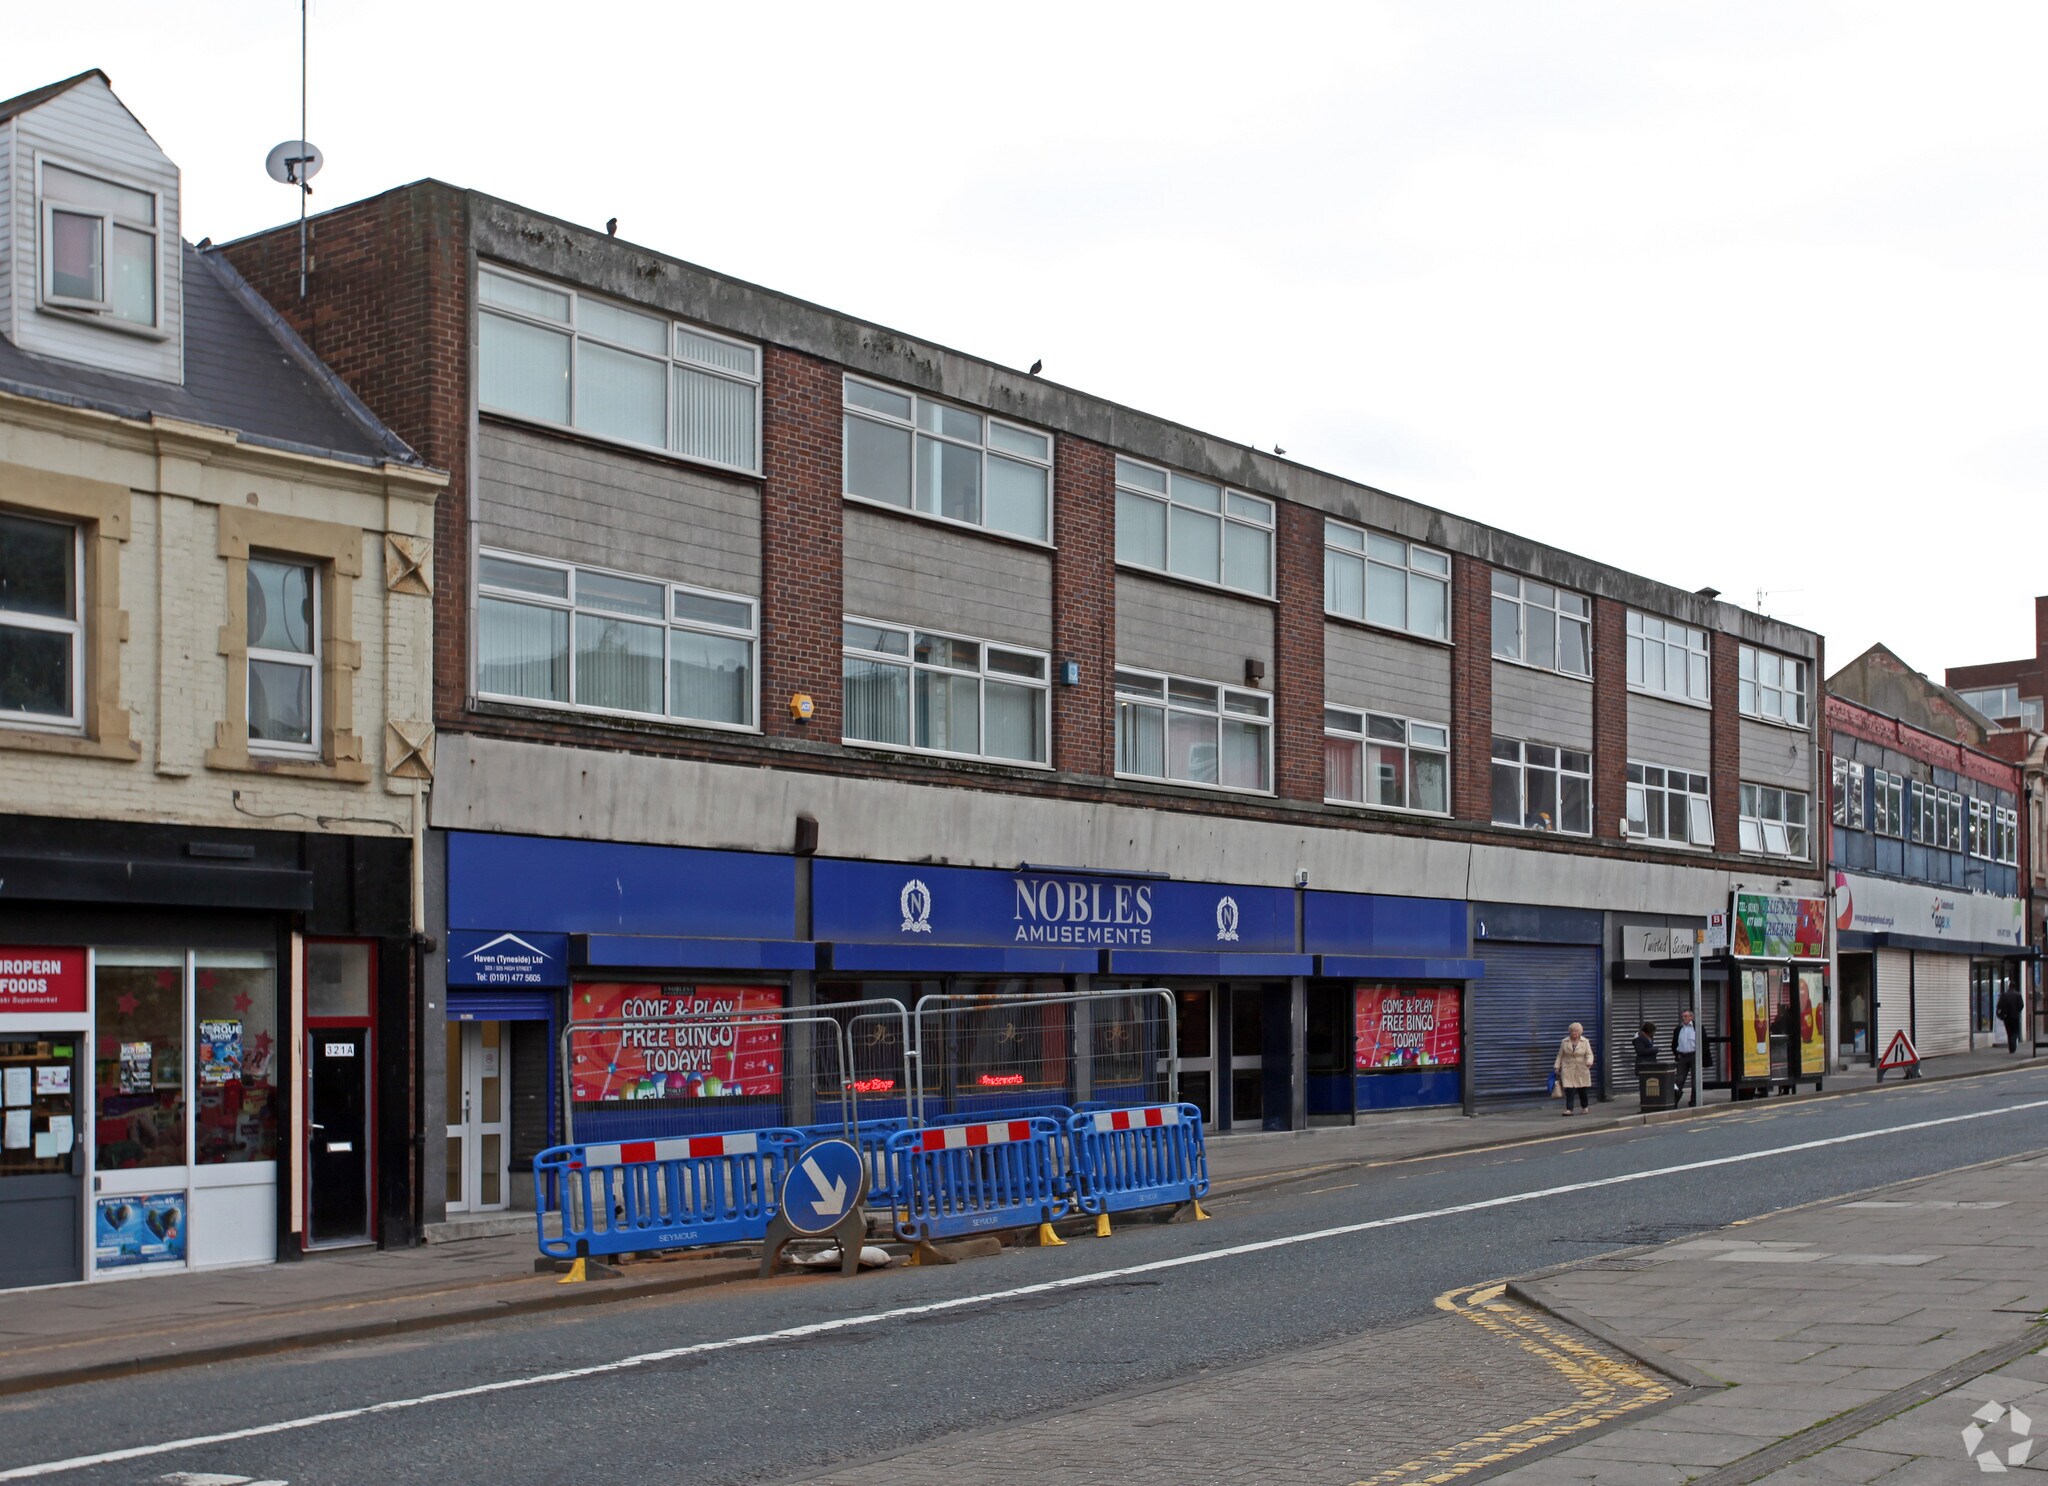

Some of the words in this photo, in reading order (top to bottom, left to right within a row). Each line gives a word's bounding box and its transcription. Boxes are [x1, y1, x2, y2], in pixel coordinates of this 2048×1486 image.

[1013, 878, 1153, 926] NOBLES
[1014, 925, 1153, 945] AMUSEMENTS
[1765, 921, 1799, 937] TAKEAWAY
[1643, 932, 1669, 953] Twisted
[473, 954, 496, 963] Haven
[496, 954, 531, 965] (Tyneside)
[532, 956, 544, 964] Ltd
[0, 978, 47, 993] FOODS
[476, 972, 488, 981] Tel:
[489, 973, 511, 983] (0191)
[511, 973, 524, 982] 477
[12, 996, 58, 1004] Supermarket
[1381, 999, 1405, 1014] COME
[1405, 999, 1413, 1013] &
[1414, 999, 1434, 1014] PLAY
[621, 999, 670, 1019] COME
[674, 999, 689, 1020] &
[693, 1000, 733, 1020] PLAY
[1381, 1014, 1405, 1031] FREE
[1406, 1014, 1434, 1031] BINGO
[621, 1021, 670, 1048] FREE
[674, 1020, 734, 1048] BINGO
[1391, 1032, 1425, 1048] TODAY!!
[326, 1045, 354, 1055] 321A
[642, 1049, 711, 1072] TODAY!!
[659, 1231, 698, 1242] SEYMOUR
